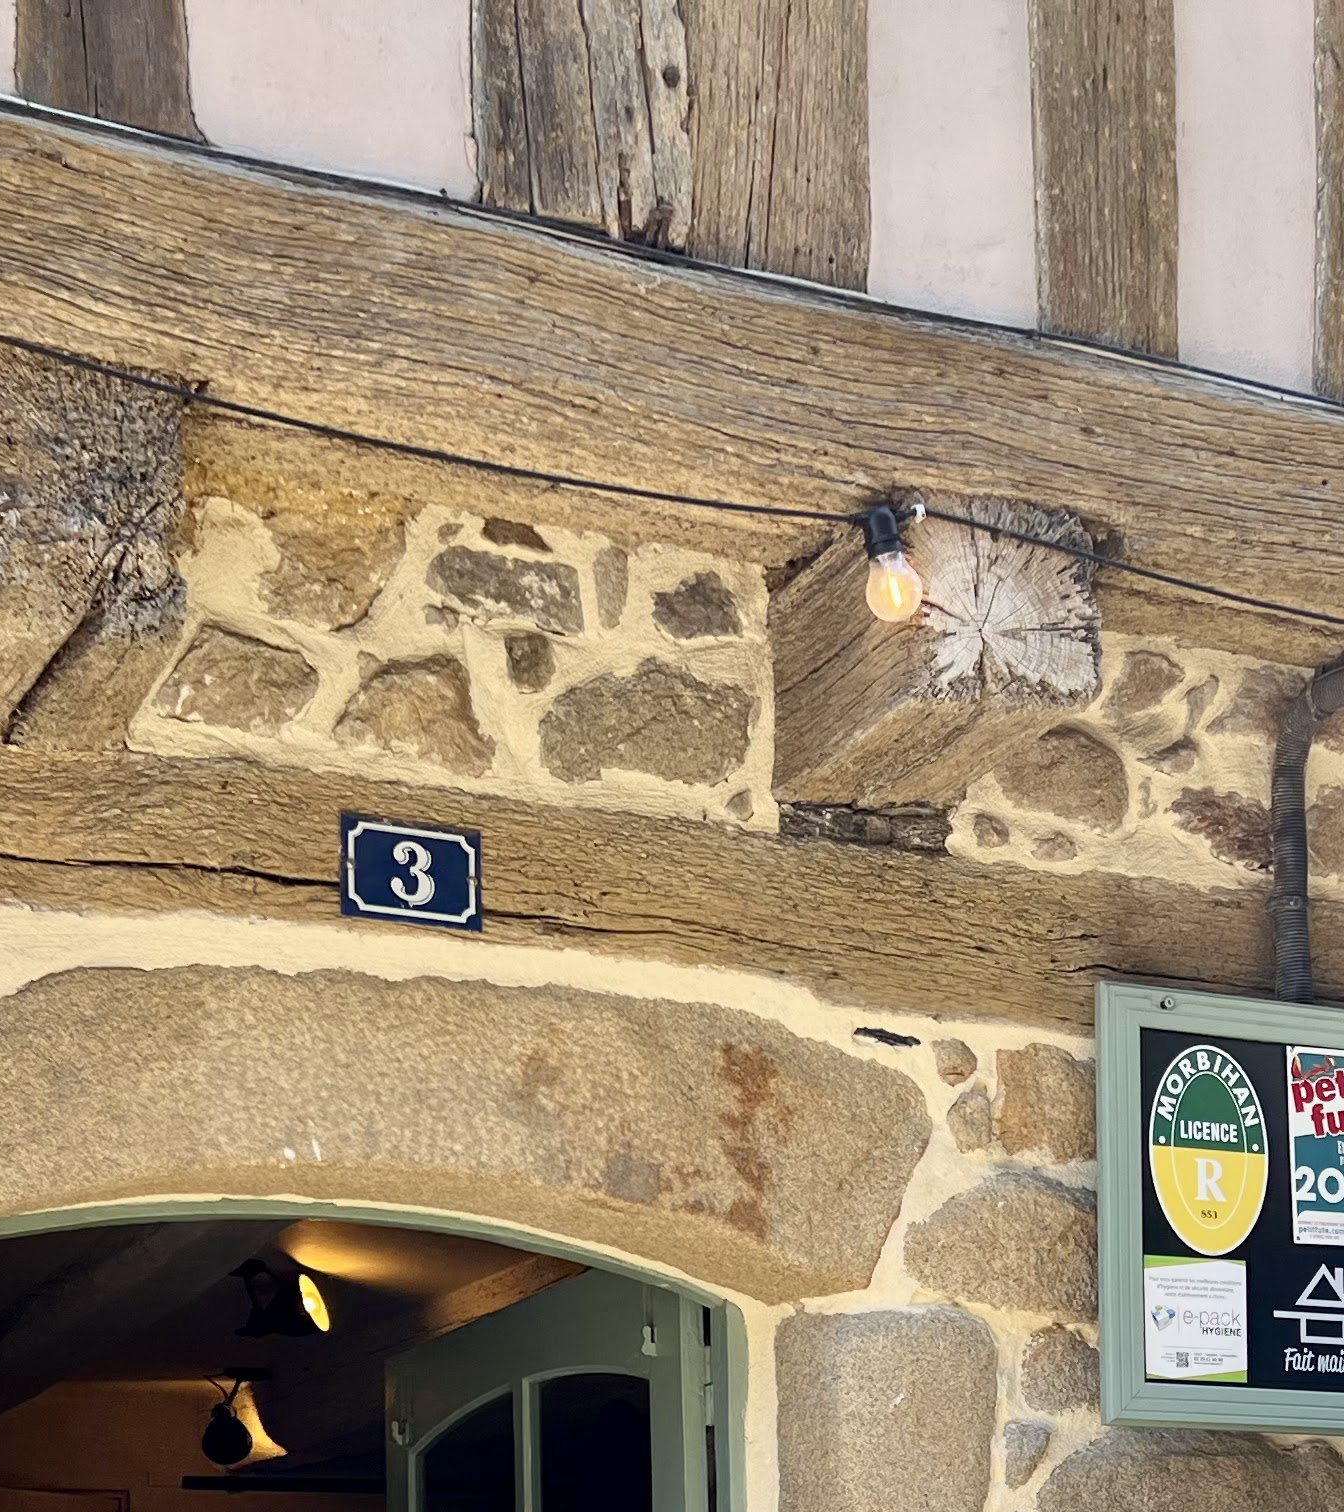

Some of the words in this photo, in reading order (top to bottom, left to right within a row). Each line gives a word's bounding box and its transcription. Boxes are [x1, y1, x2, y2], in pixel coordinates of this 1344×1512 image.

[390, 840, 436, 907] 3
[1157, 1051, 1260, 1127] MORBIHAN
[1179, 1119, 1239, 1143] LICENCE
[1194, 1157, 1227, 1202] R
[1182, 1308, 1241, 1328] e-pack
[1202, 1327, 1242, 1337] HYGIENE
[1283, 1347, 1315, 1372] Fait
